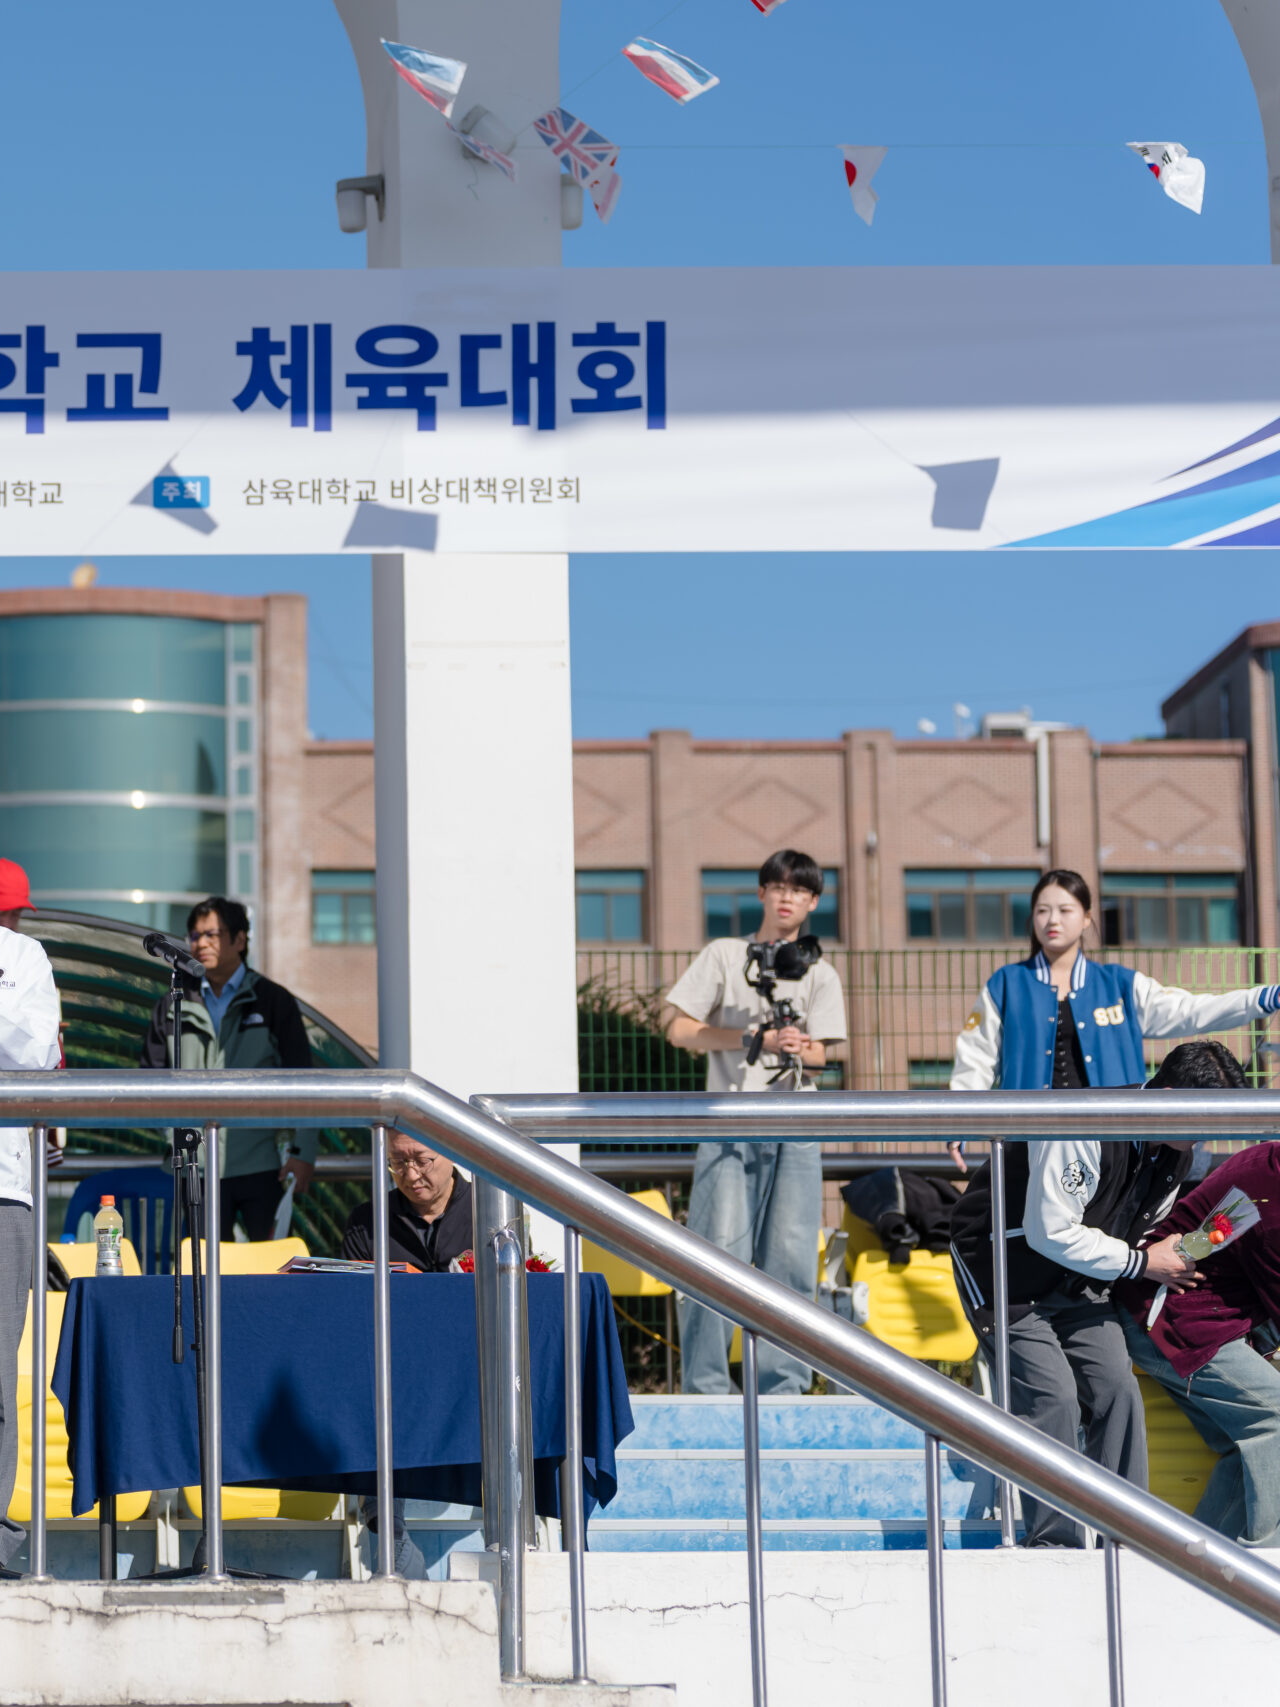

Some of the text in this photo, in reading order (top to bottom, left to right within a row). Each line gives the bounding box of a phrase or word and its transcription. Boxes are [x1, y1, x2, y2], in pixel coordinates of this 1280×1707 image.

[231, 320, 667, 433] 체육대회
[161, 480, 202, 503] 주최
[242, 476, 581, 505] 삼육대학교 비상대책위원회
[1093, 1004, 1125, 1027] SU
